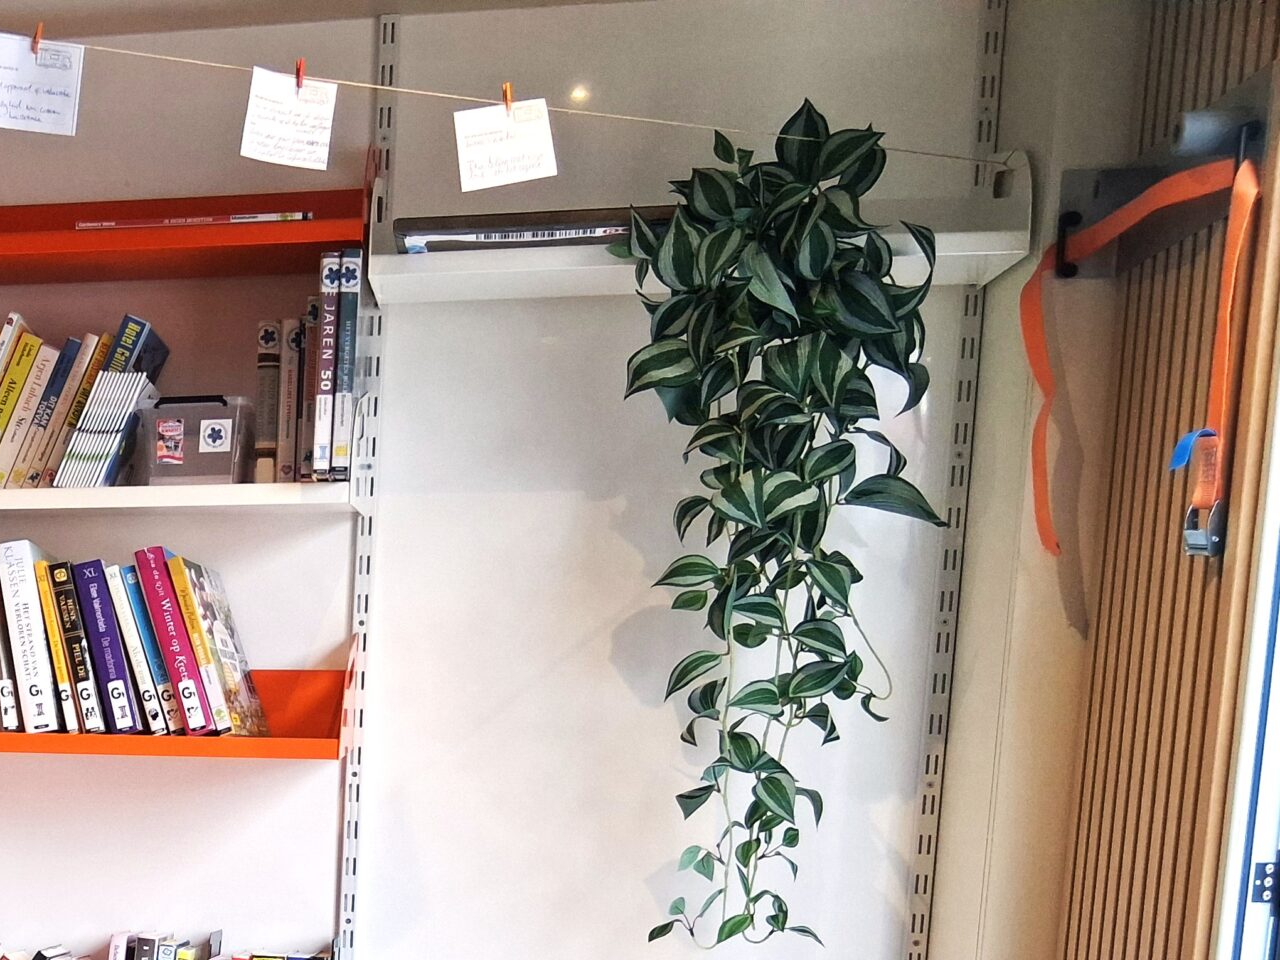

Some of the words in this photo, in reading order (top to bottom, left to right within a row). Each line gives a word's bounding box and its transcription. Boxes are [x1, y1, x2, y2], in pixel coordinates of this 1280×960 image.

[119, 322, 142, 348] Hotel
[321, 304, 335, 359] JAREN
[0, 377, 17, 406] Alleen
[4, 546, 19, 598] KLASSEN
[89, 583, 101, 598] Elise
[14, 602, 25, 647] VERLOREN
[22, 602, 30, 620] HET
[59, 595, 71, 628] VAESSEN
[66, 599, 76, 621] HENK
[160, 598, 177, 636] Winter
[170, 640, 182, 652] op
[25, 623, 35, 657] STRAND
[101, 637, 111, 647] De
[76, 665, 86, 678] DE
[104, 648, 118, 678] madonna
